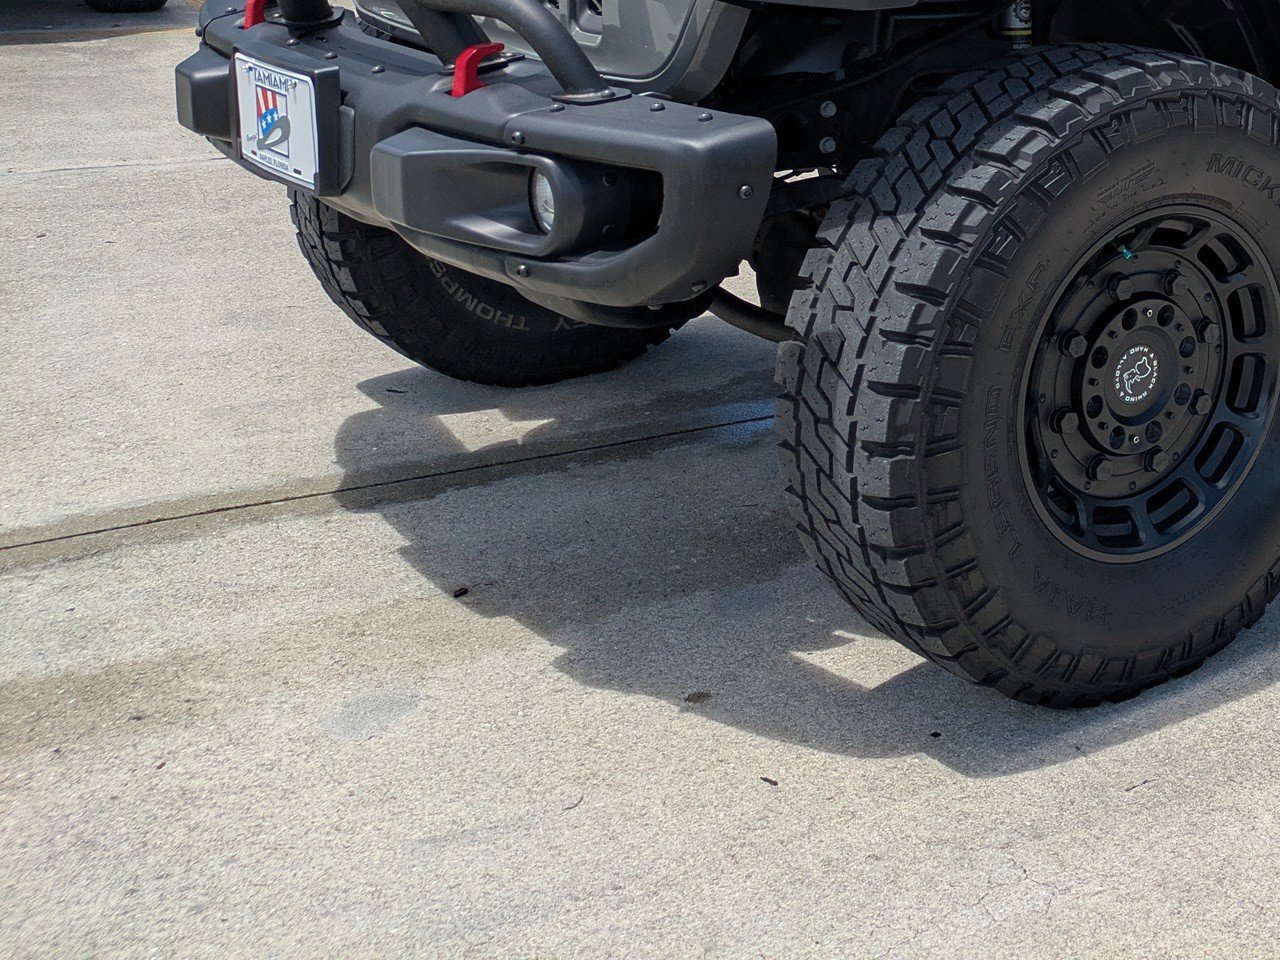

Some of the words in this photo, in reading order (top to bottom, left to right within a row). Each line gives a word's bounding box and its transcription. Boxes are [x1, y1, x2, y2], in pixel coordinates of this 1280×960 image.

[253, 66, 290, 93] TAMIAMI
[428, 259, 530, 332] THOMPS
[1129, 345, 1149, 355] HARD
[1115, 354, 1128, 390] ALLOYS
[1148, 359, 1159, 390] BLACK
[1124, 390, 1148, 403] RHINO
[983, 384, 1022, 561] LEGEND
